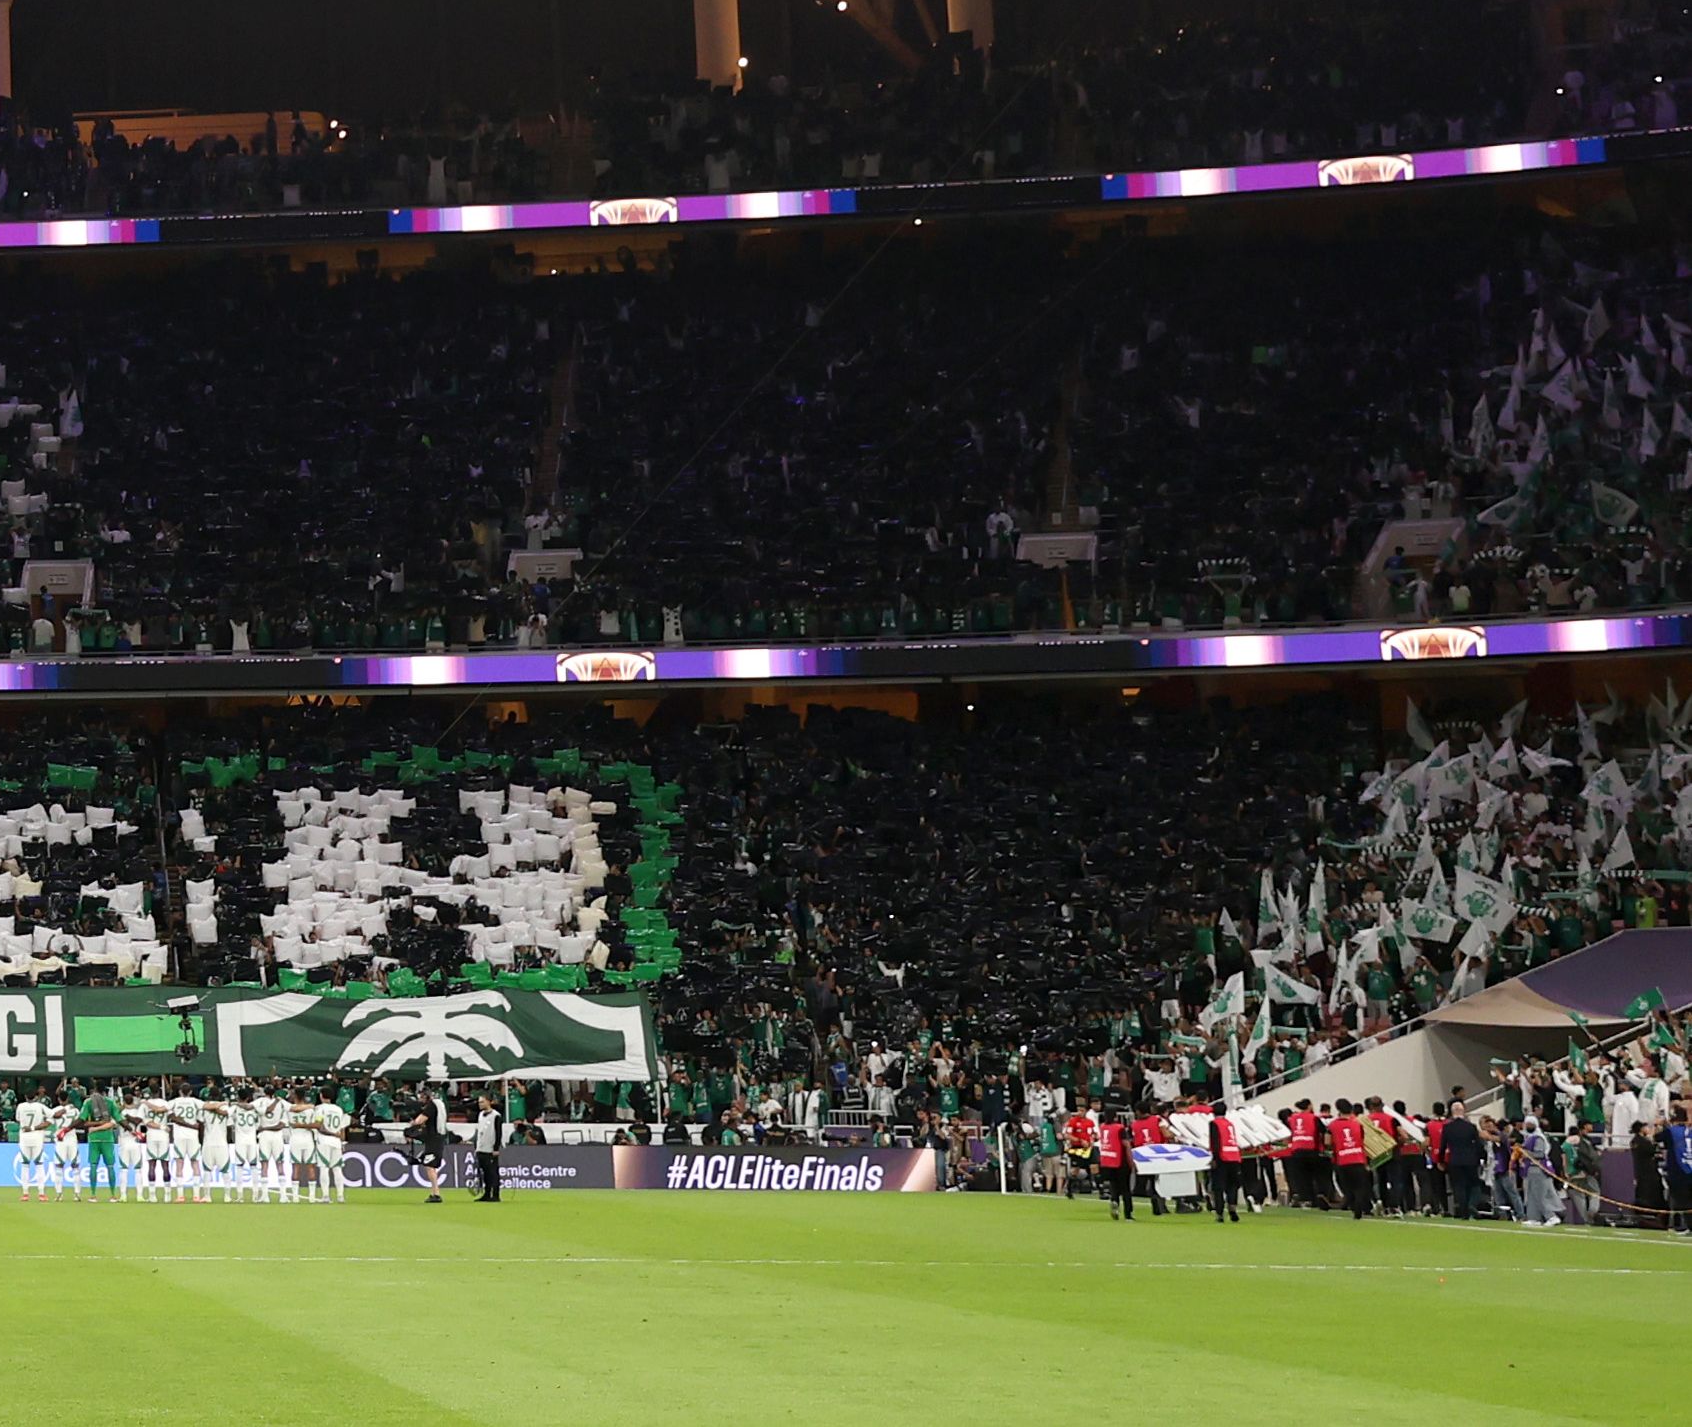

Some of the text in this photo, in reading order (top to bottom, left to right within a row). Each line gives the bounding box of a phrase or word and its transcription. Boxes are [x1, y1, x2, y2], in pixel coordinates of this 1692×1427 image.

[176, 1105, 195, 1120] 28
[26, 1113, 35, 1128] 7
[237, 1113, 255, 1128] 30
[326, 1113, 341, 1129] 10
[532, 1164, 577, 1177] Centre
[667, 1154, 883, 1192] #ACLEliteFinals
